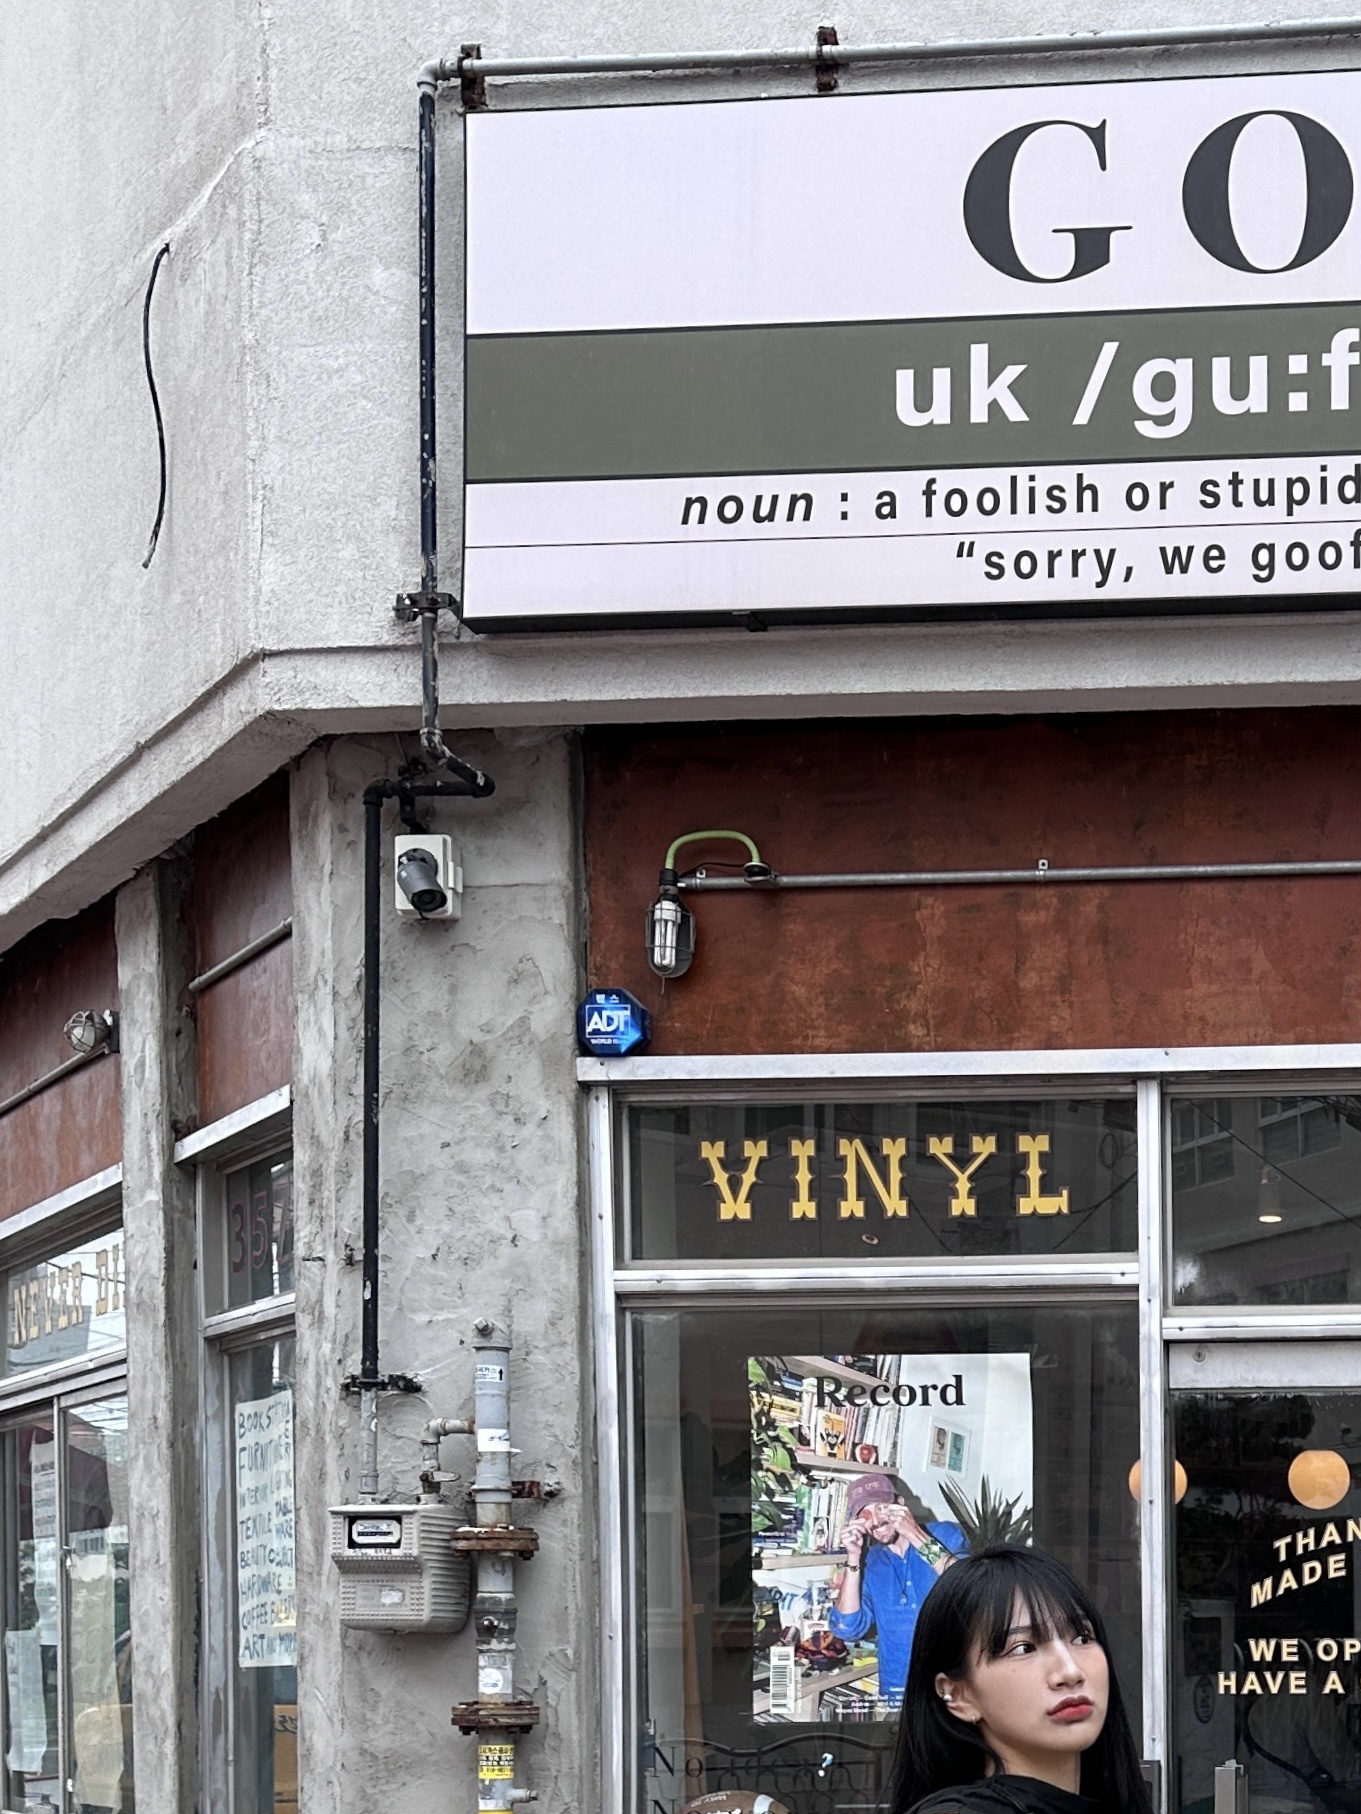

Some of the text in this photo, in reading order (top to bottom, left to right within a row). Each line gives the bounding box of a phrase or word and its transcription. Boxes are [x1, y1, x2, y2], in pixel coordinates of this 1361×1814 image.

[895, 343, 1030, 427] uk
[681, 492, 814, 526] noun
[875, 490, 897, 520] a
[921, 472, 1099, 518] foolish
[1125, 480, 1175, 512] or
[1199, 463, 1361, 517] stupid
[1158, 543, 1226, 575] we
[587, 1010, 630, 1032] ADT
[700, 1134, 1069, 1221] VINYL
[11, 1261, 84, 1348] NEVER
[815, 1374, 966, 1409] Record
[1251, 1549, 1346, 1608] MADE
[241, 1633, 266, 1660] ART
[1249, 1638, 1299, 1662] WE
[1218, 1671, 1307, 1694] HAVE
[1323, 1671, 1344, 1694] A
[654, 1746, 703, 1778] No
